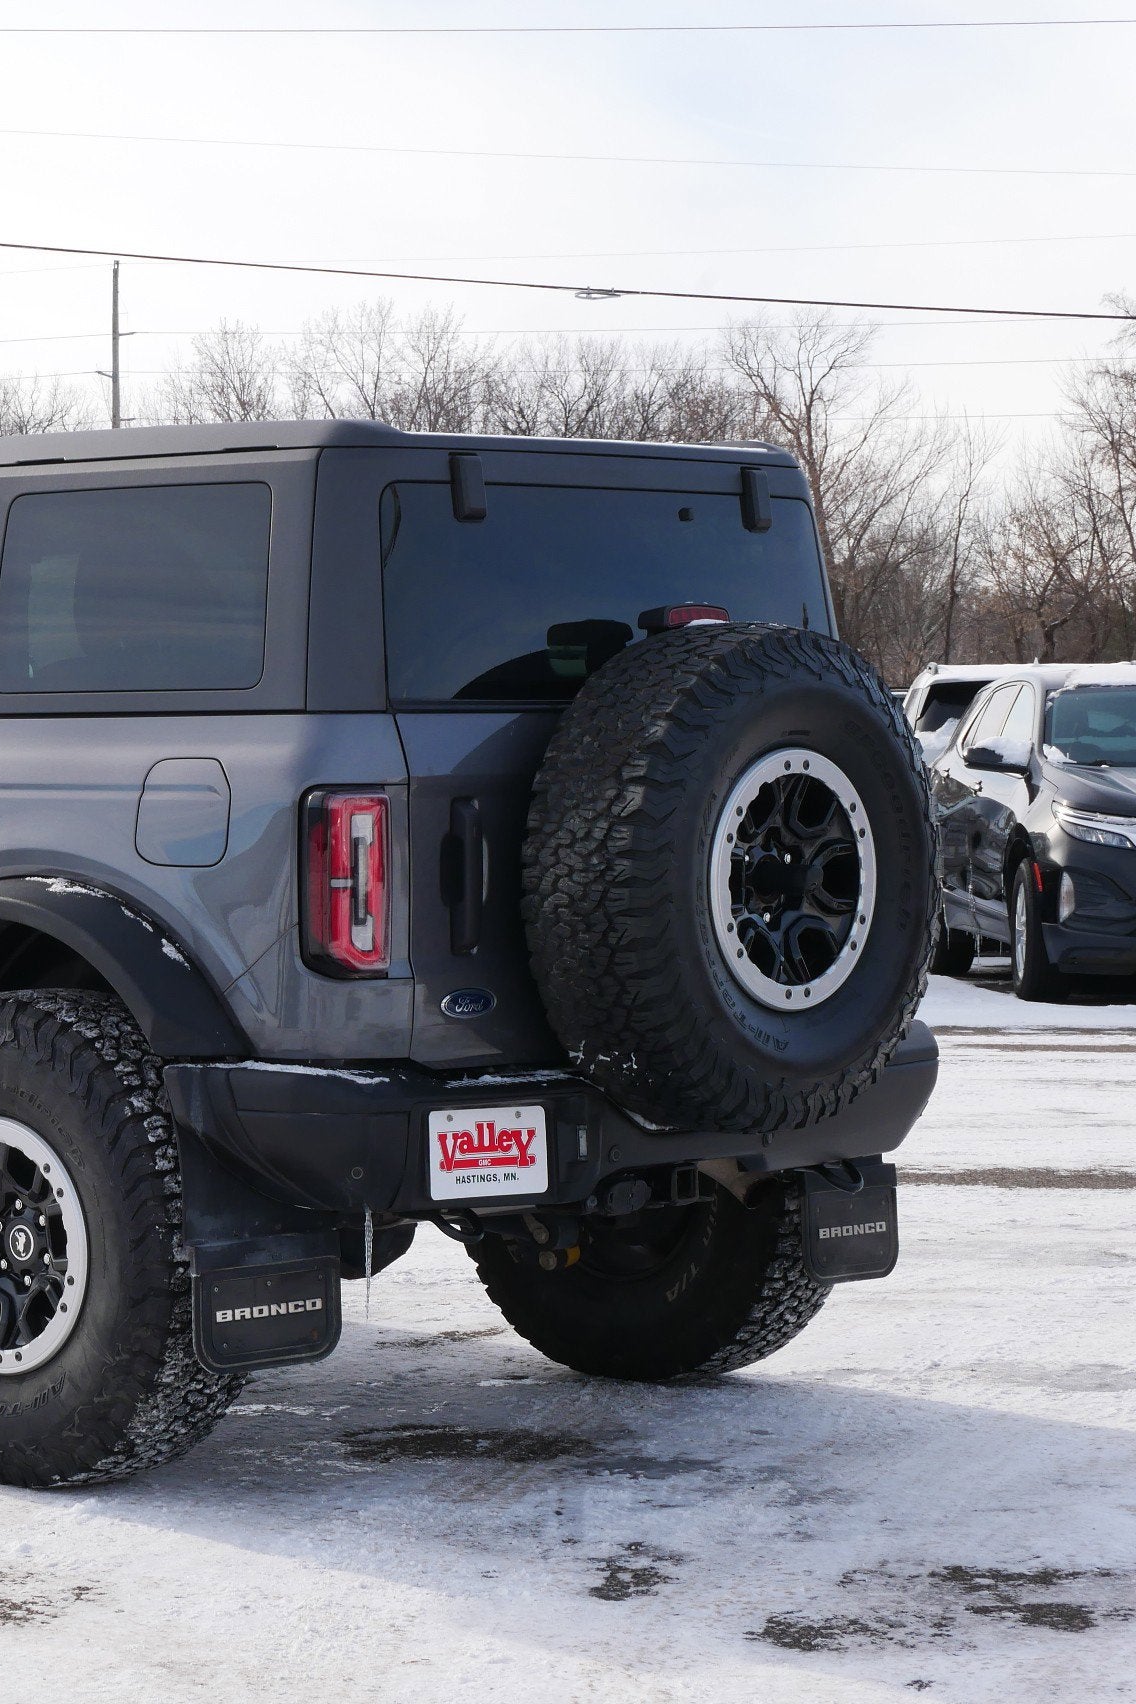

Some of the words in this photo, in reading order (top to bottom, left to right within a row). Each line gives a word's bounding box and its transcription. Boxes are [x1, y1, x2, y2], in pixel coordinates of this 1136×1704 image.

[437, 1120, 536, 1173] Valley
[478, 1158, 492, 1166] GMC
[455, 1174, 501, 1185] HASTINGS,
[503, 1173, 520, 1182] MN.
[818, 1221, 887, 1239] BRONCO
[215, 1298, 323, 1323] BRONCO
